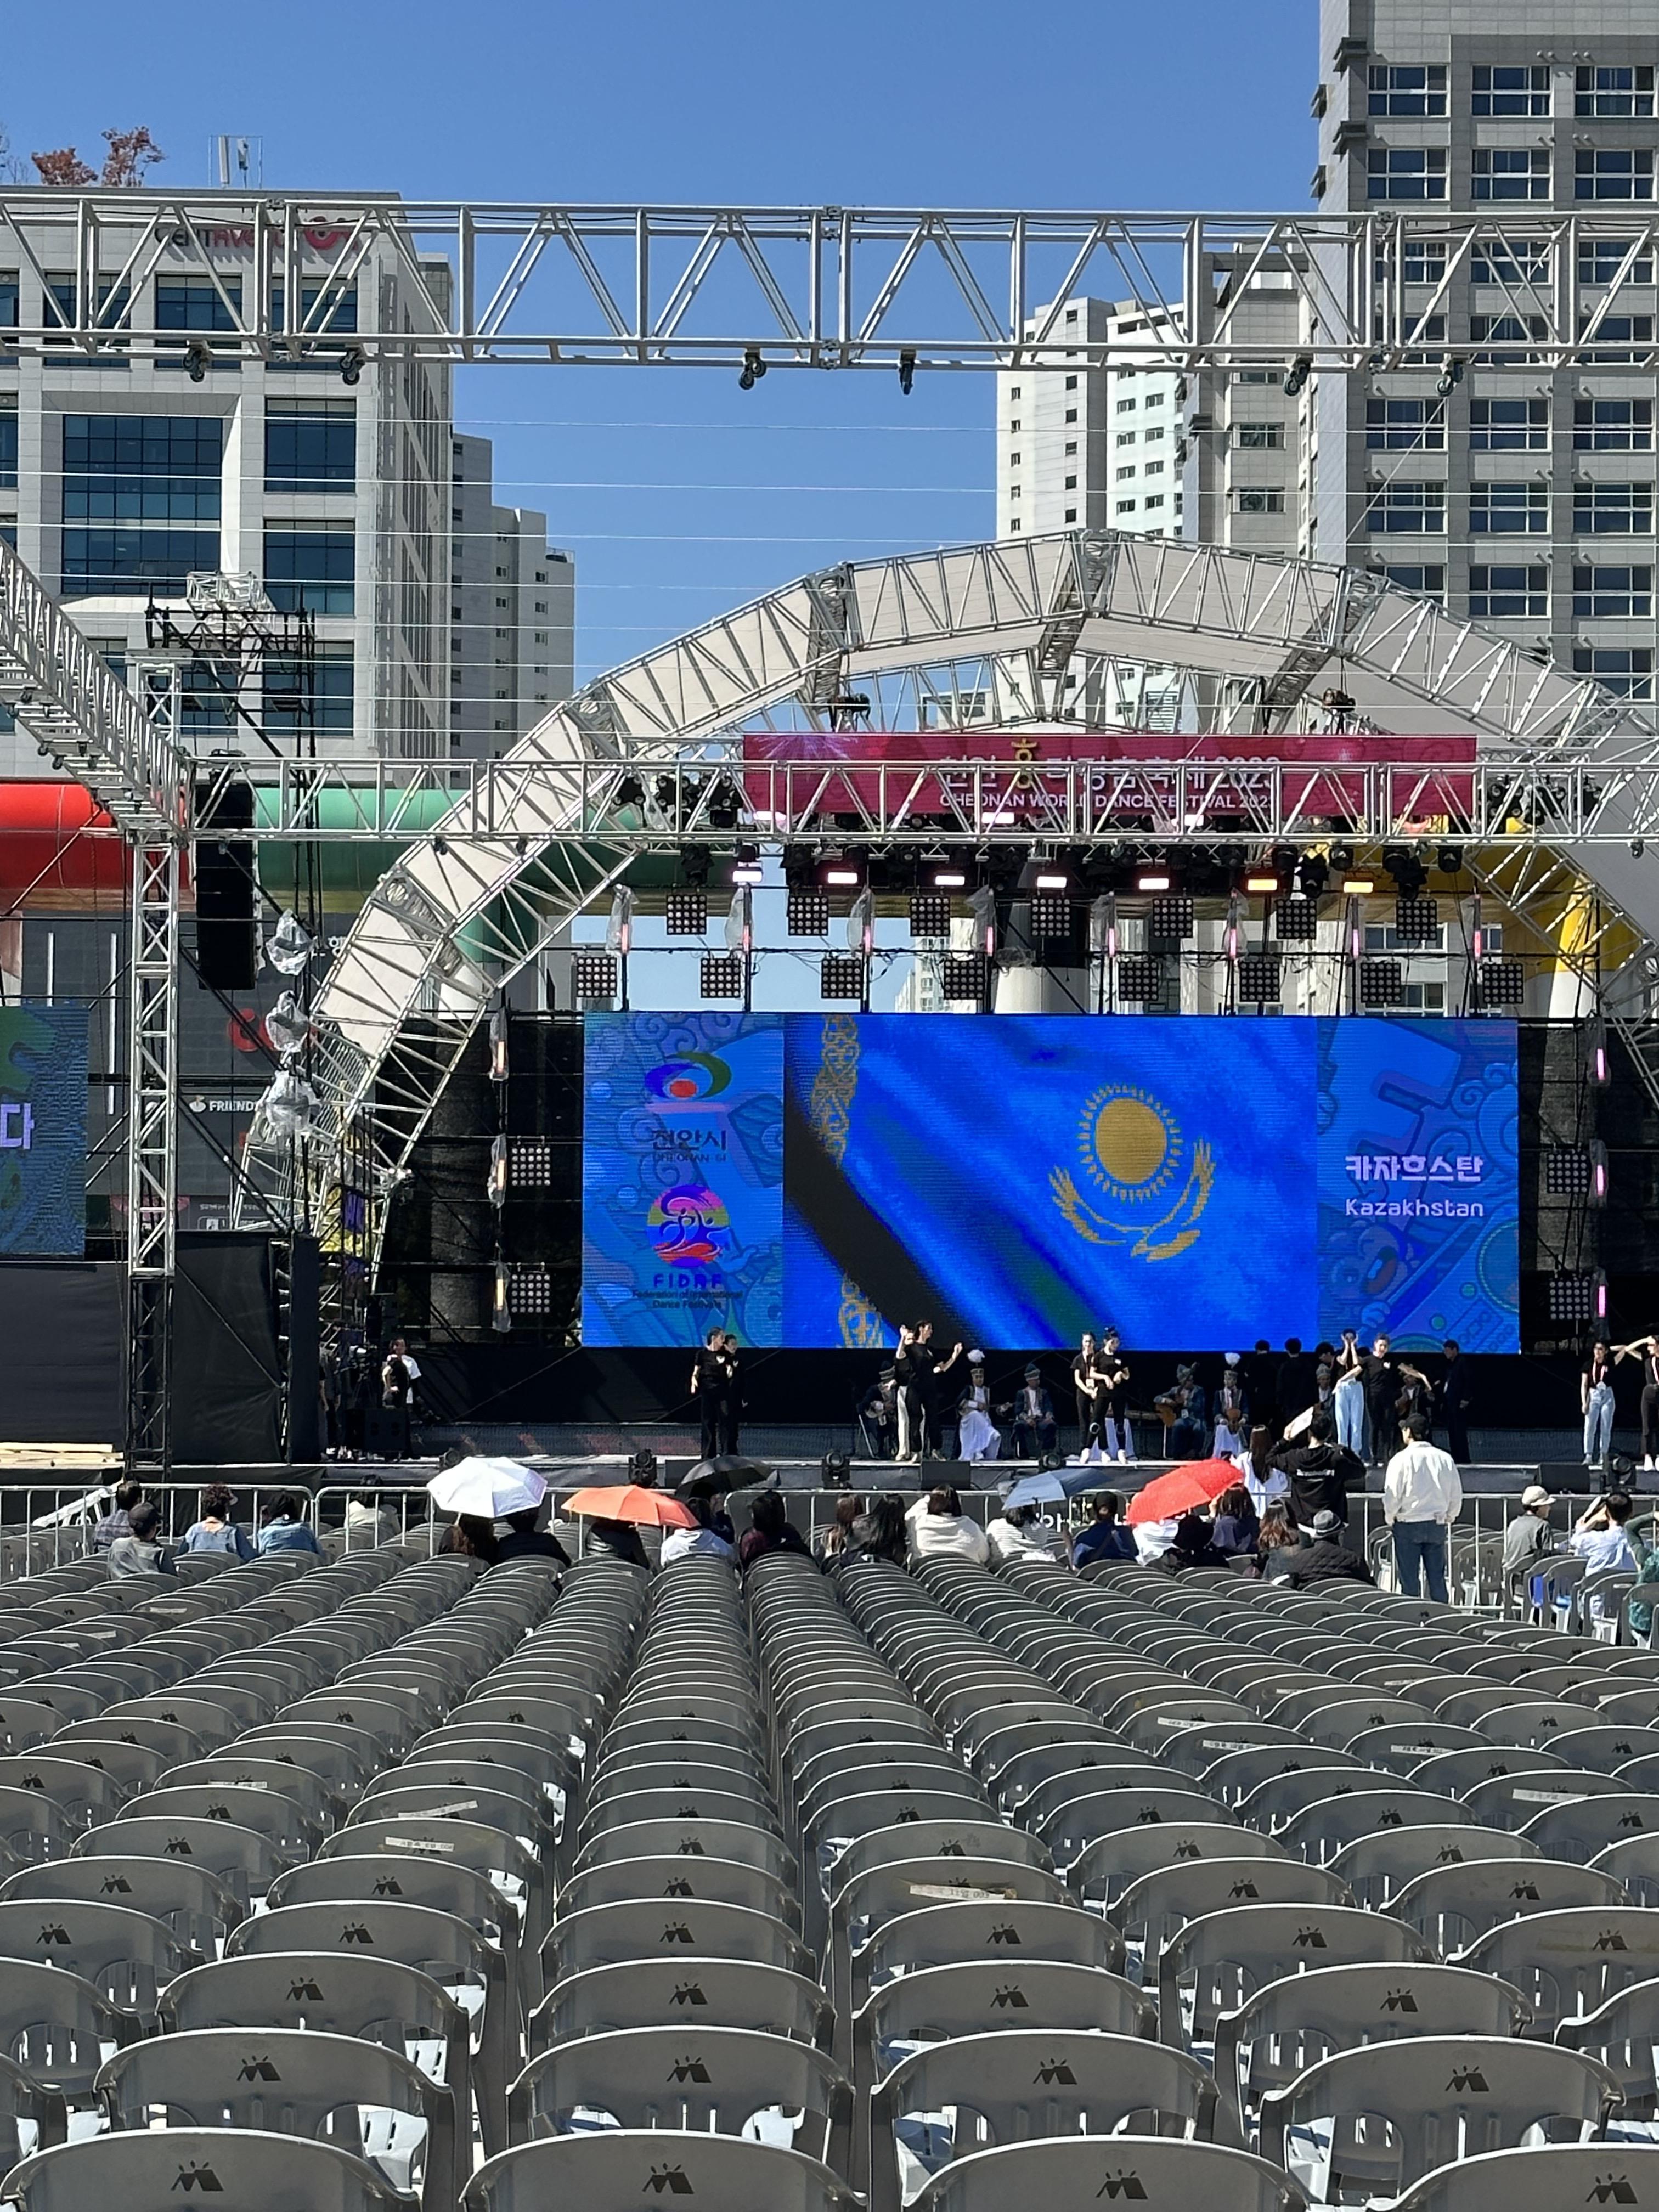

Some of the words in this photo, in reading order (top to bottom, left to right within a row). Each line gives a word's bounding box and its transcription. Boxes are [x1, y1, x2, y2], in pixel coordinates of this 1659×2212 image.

[1029, 794, 1091, 808] WOR
[1159, 795, 1236, 808] FETIVAL
[1239, 795, 1274, 808] 202
[651, 1129, 727, 1151] 천안시
[1345, 1155, 1483, 1182] 카자흐스탄
[1345, 1199, 1483, 1216] Kazakhstan
